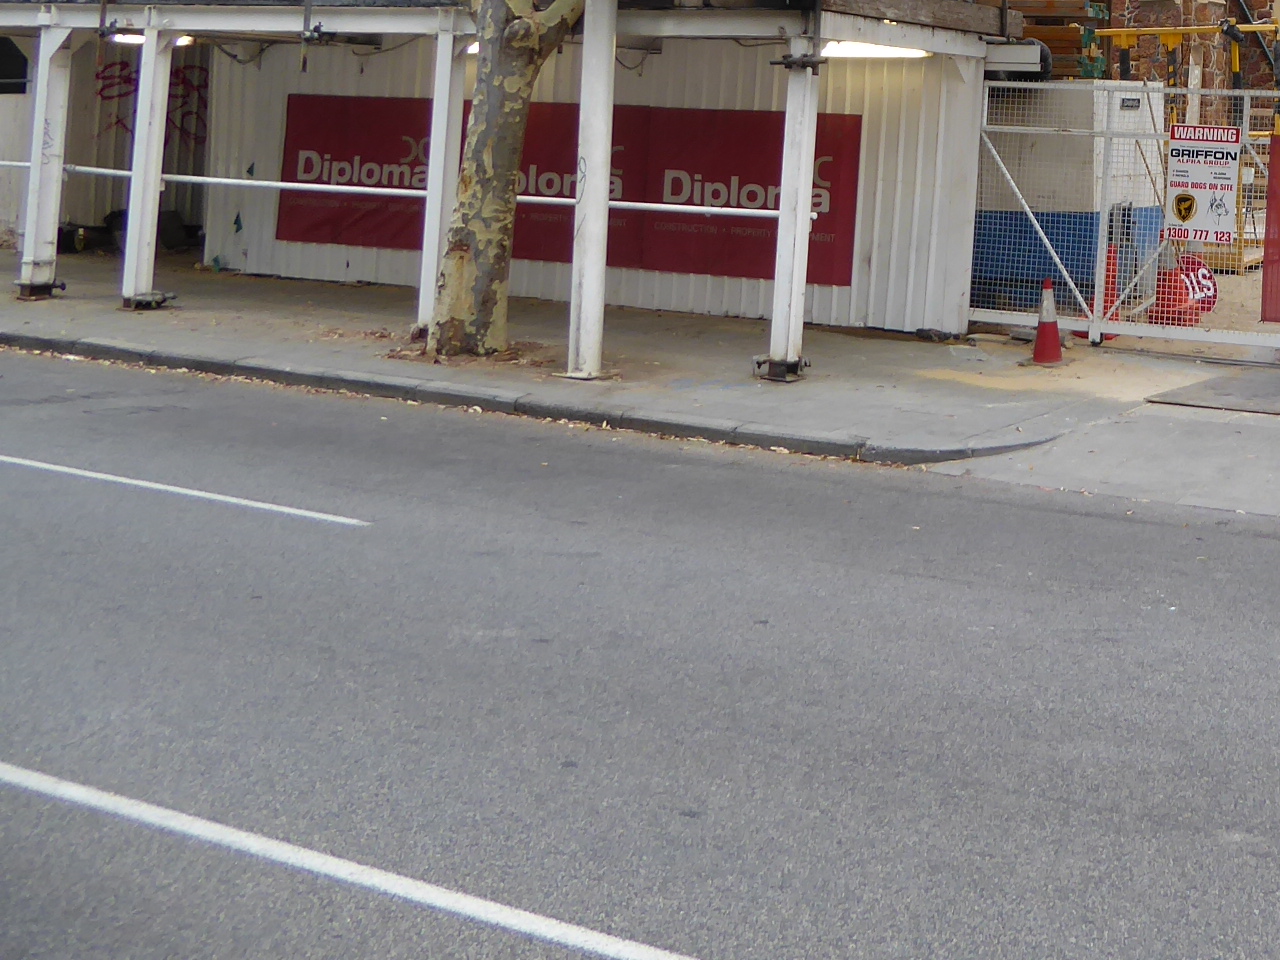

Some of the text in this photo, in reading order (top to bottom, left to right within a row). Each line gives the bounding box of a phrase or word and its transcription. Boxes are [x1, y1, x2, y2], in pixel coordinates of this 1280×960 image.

[1174, 126, 1237, 142] WARNING
[1170, 148, 1238, 161] GRIFFON
[1169, 180, 1234, 192] GUARD DOGS ON SITE
[1166, 227, 1232, 243] 1300 777 123
